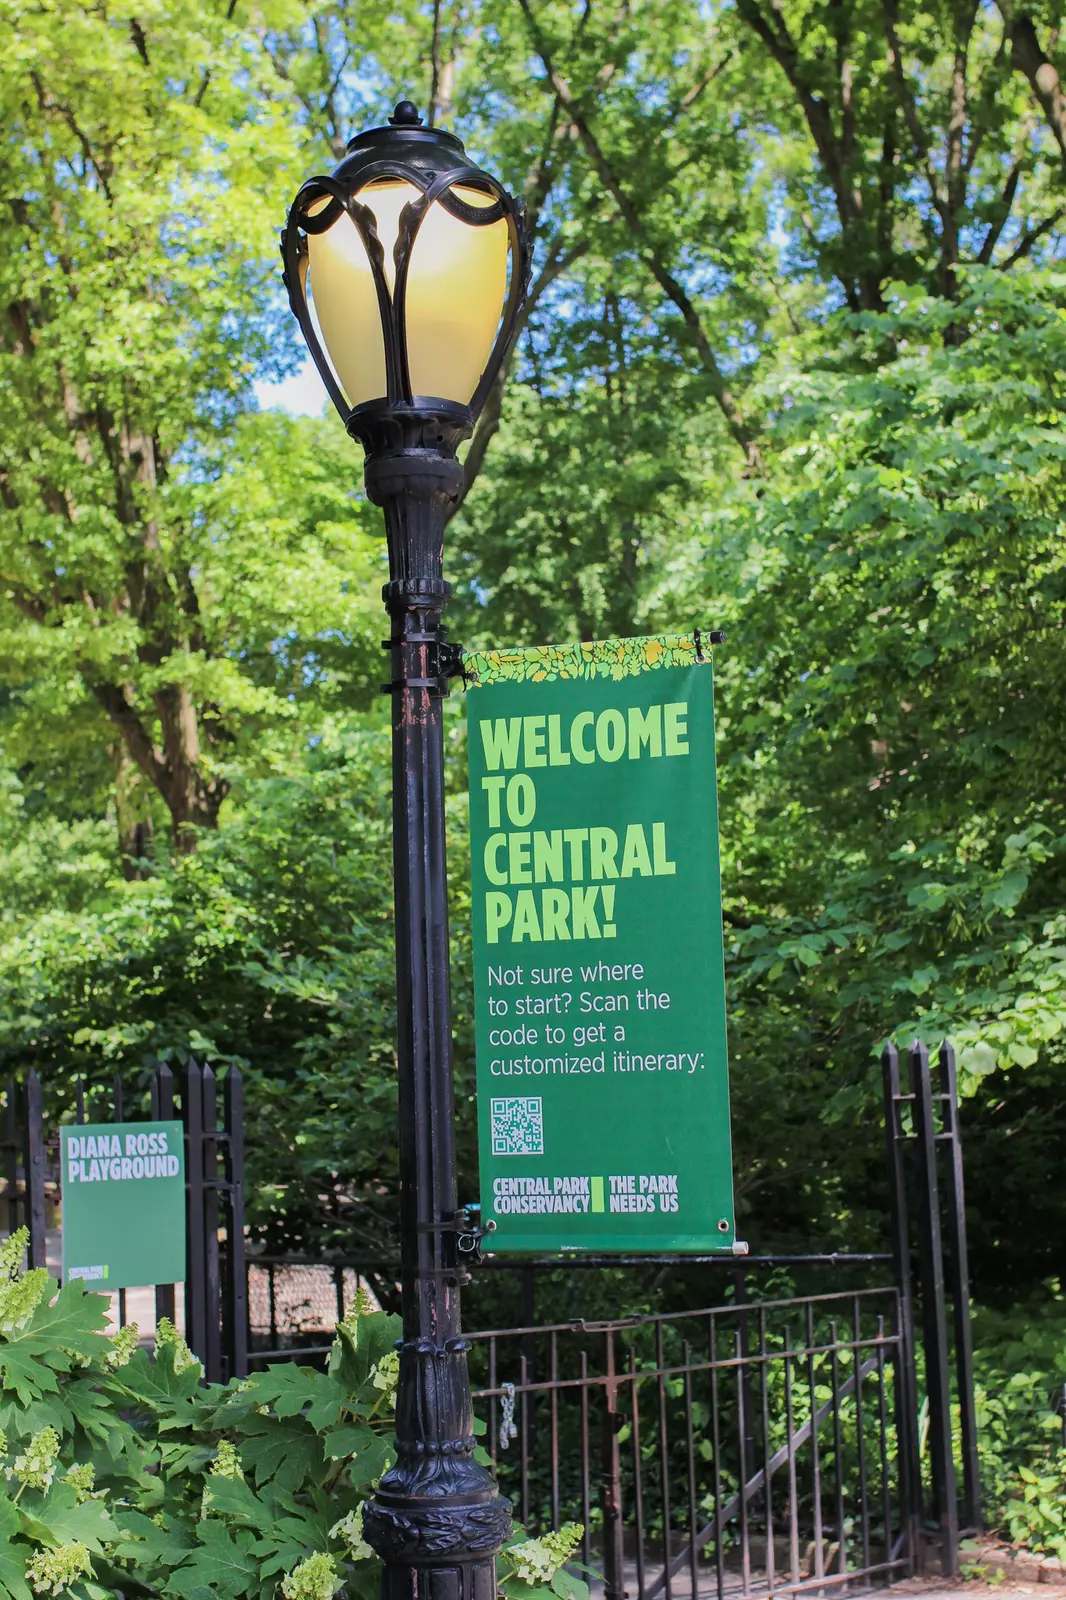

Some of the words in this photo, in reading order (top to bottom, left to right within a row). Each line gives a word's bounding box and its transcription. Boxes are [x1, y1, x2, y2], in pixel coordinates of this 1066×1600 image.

[479, 702, 689, 770] WELCOME
[482, 774, 536, 828] TO
[484, 822, 676, 886] CENTRAL
[486, 885, 616, 943] PARK!
[488, 965, 524, 986] Not
[530, 966, 573, 985] sure
[580, 961, 644, 982] where
[488, 996, 508, 1016] to
[515, 993, 572, 1015] start?
[580, 992, 628, 1012] Scan
[636, 989, 670, 1010] the
[489, 1024, 538, 1045] code
[545, 1024, 565, 1044] to
[573, 1022, 606, 1046] get
[614, 1025, 626, 1041] a
[490, 1051, 605, 1076] customized
[613, 1051, 705, 1074] itinerary:
[68, 1135, 122, 1159] DIANA
[126, 1132, 168, 1156] ROSS
[68, 1155, 179, 1182] PLAYGROUND
[493, 1177, 552, 1195] CENTRAL
[553, 1177, 590, 1195] PARK
[609, 1175, 635, 1193] THE
[639, 1175, 678, 1193] PARK
[493, 1195, 590, 1214] CONSERVANCY
[609, 1194, 656, 1213] NEEDS
[659, 1194, 679, 1212] US
